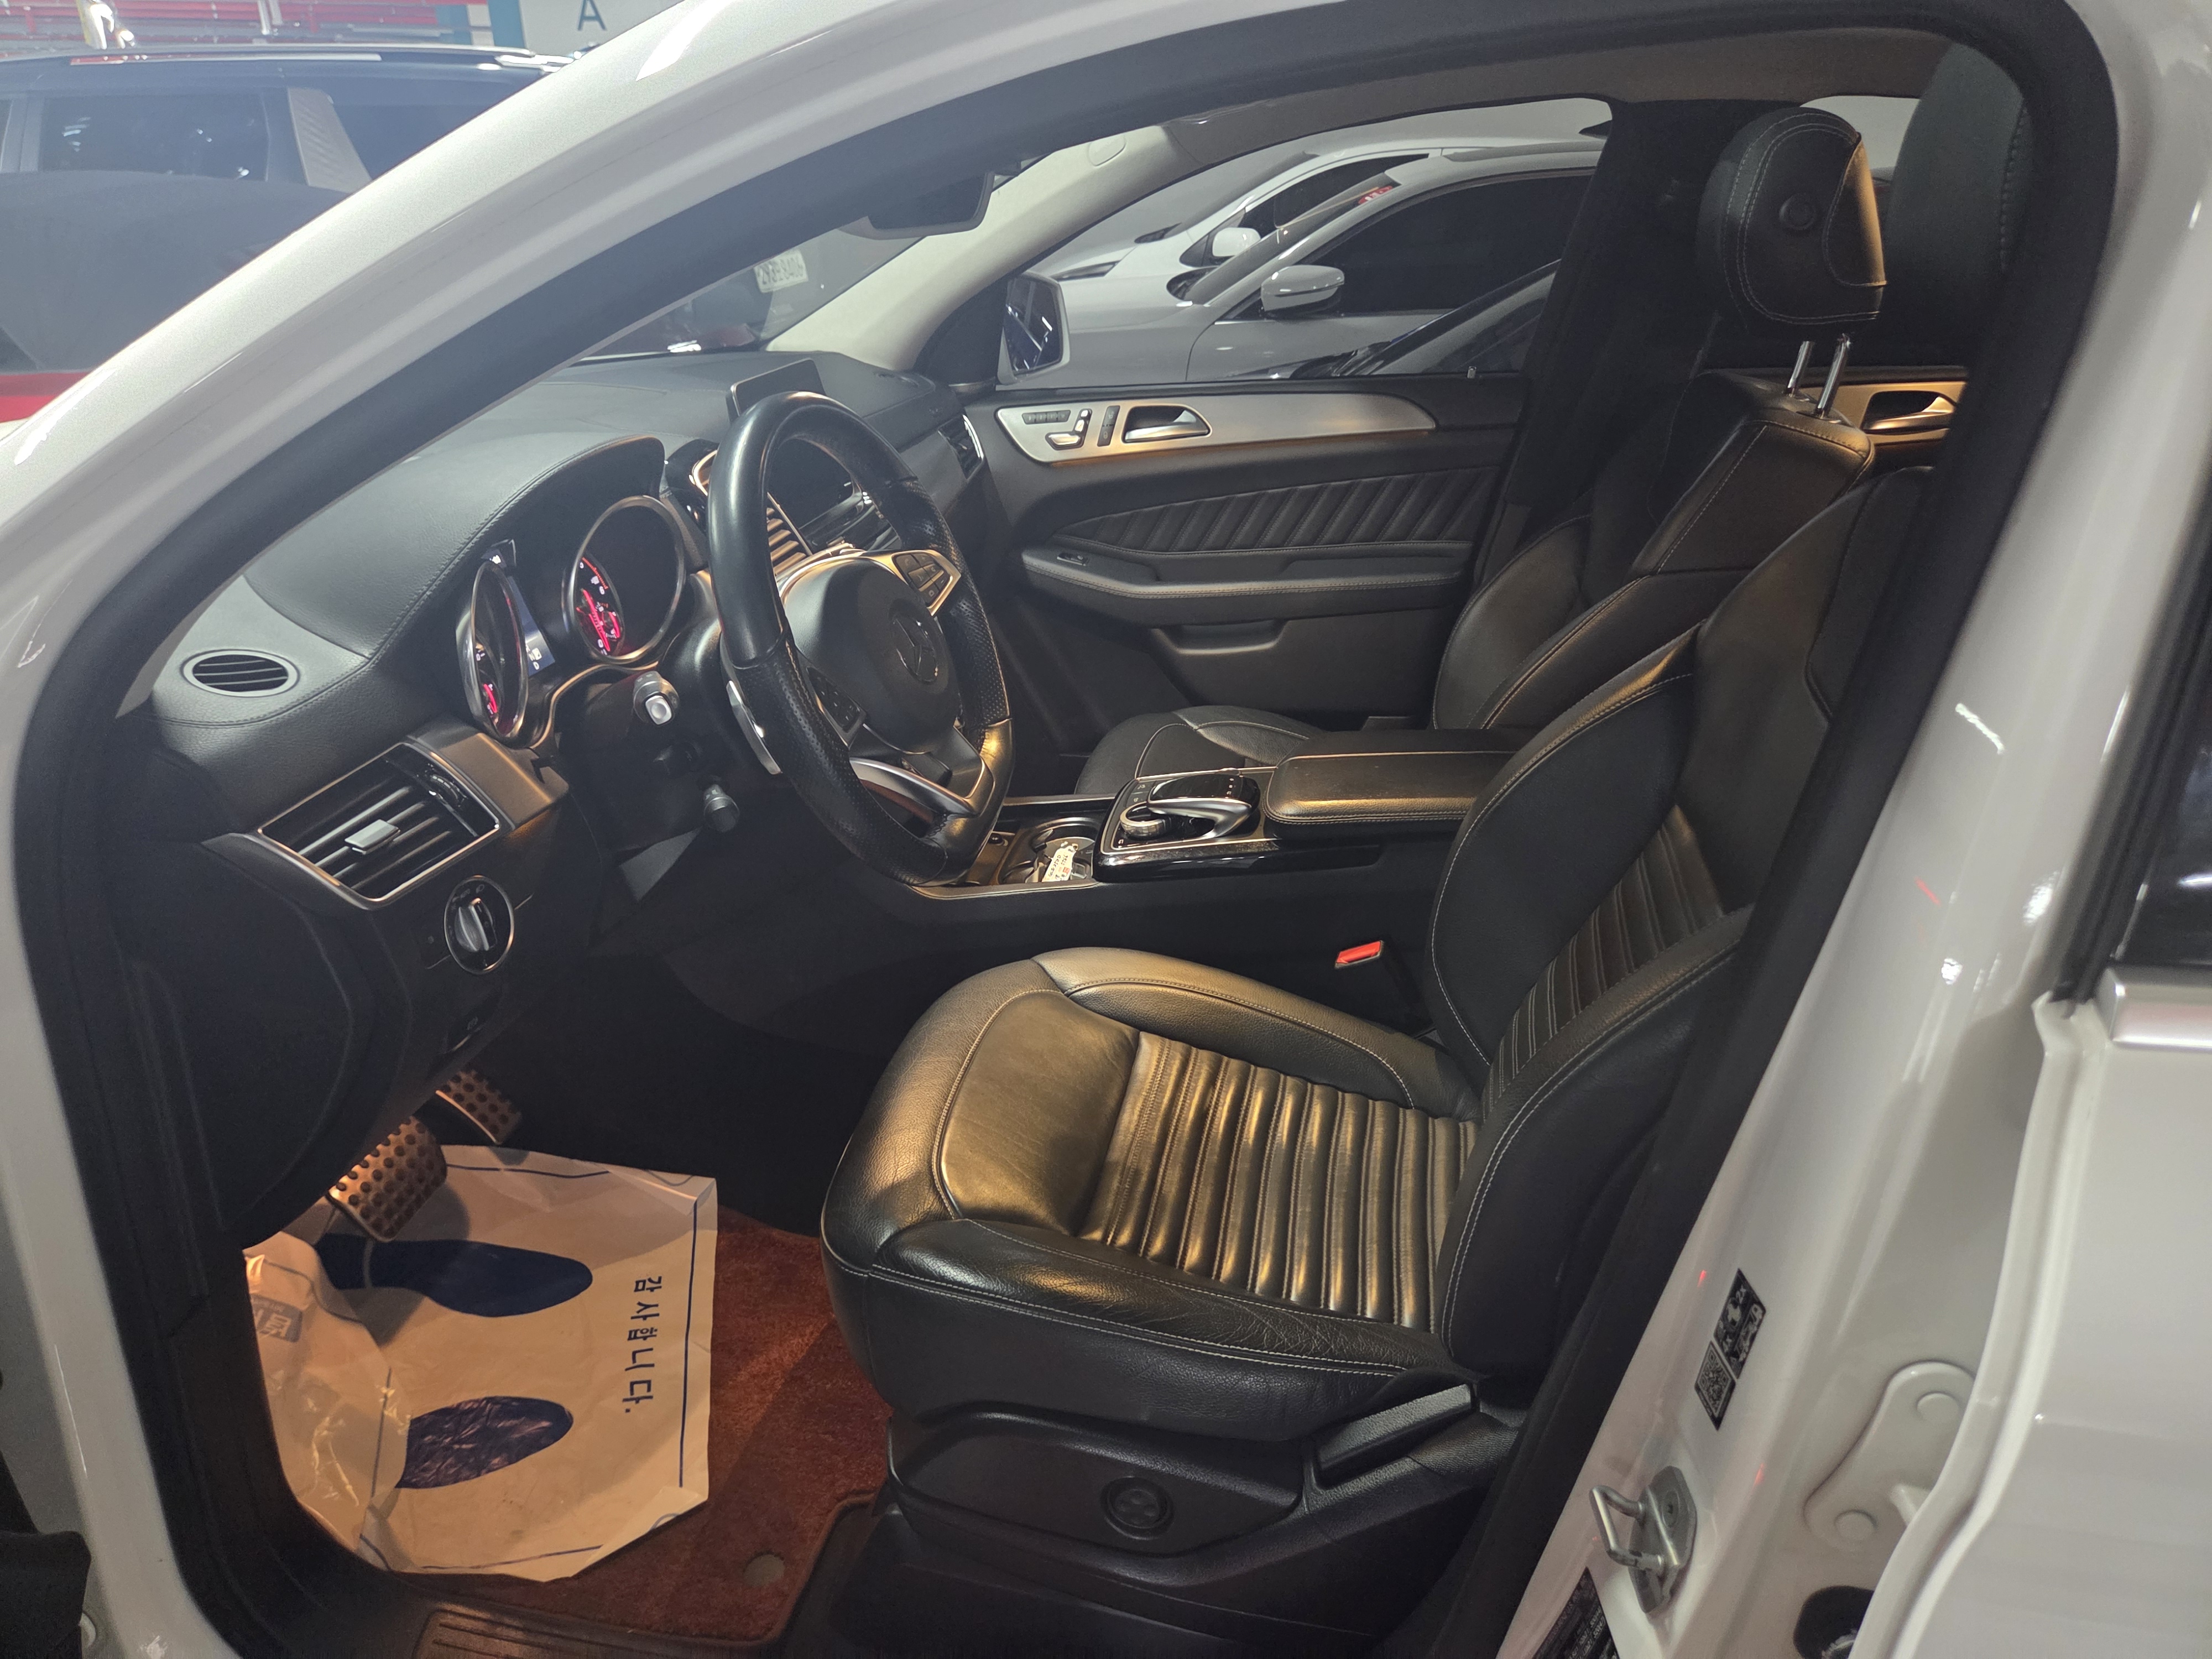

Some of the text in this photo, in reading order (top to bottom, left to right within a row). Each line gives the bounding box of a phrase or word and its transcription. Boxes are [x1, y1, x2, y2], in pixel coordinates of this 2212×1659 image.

[577, 0, 607, 32] A
[598, 639, 603, 648] 0
[533, 661, 540, 670] D
[622, 1276, 662, 1413] 감사합니다.
